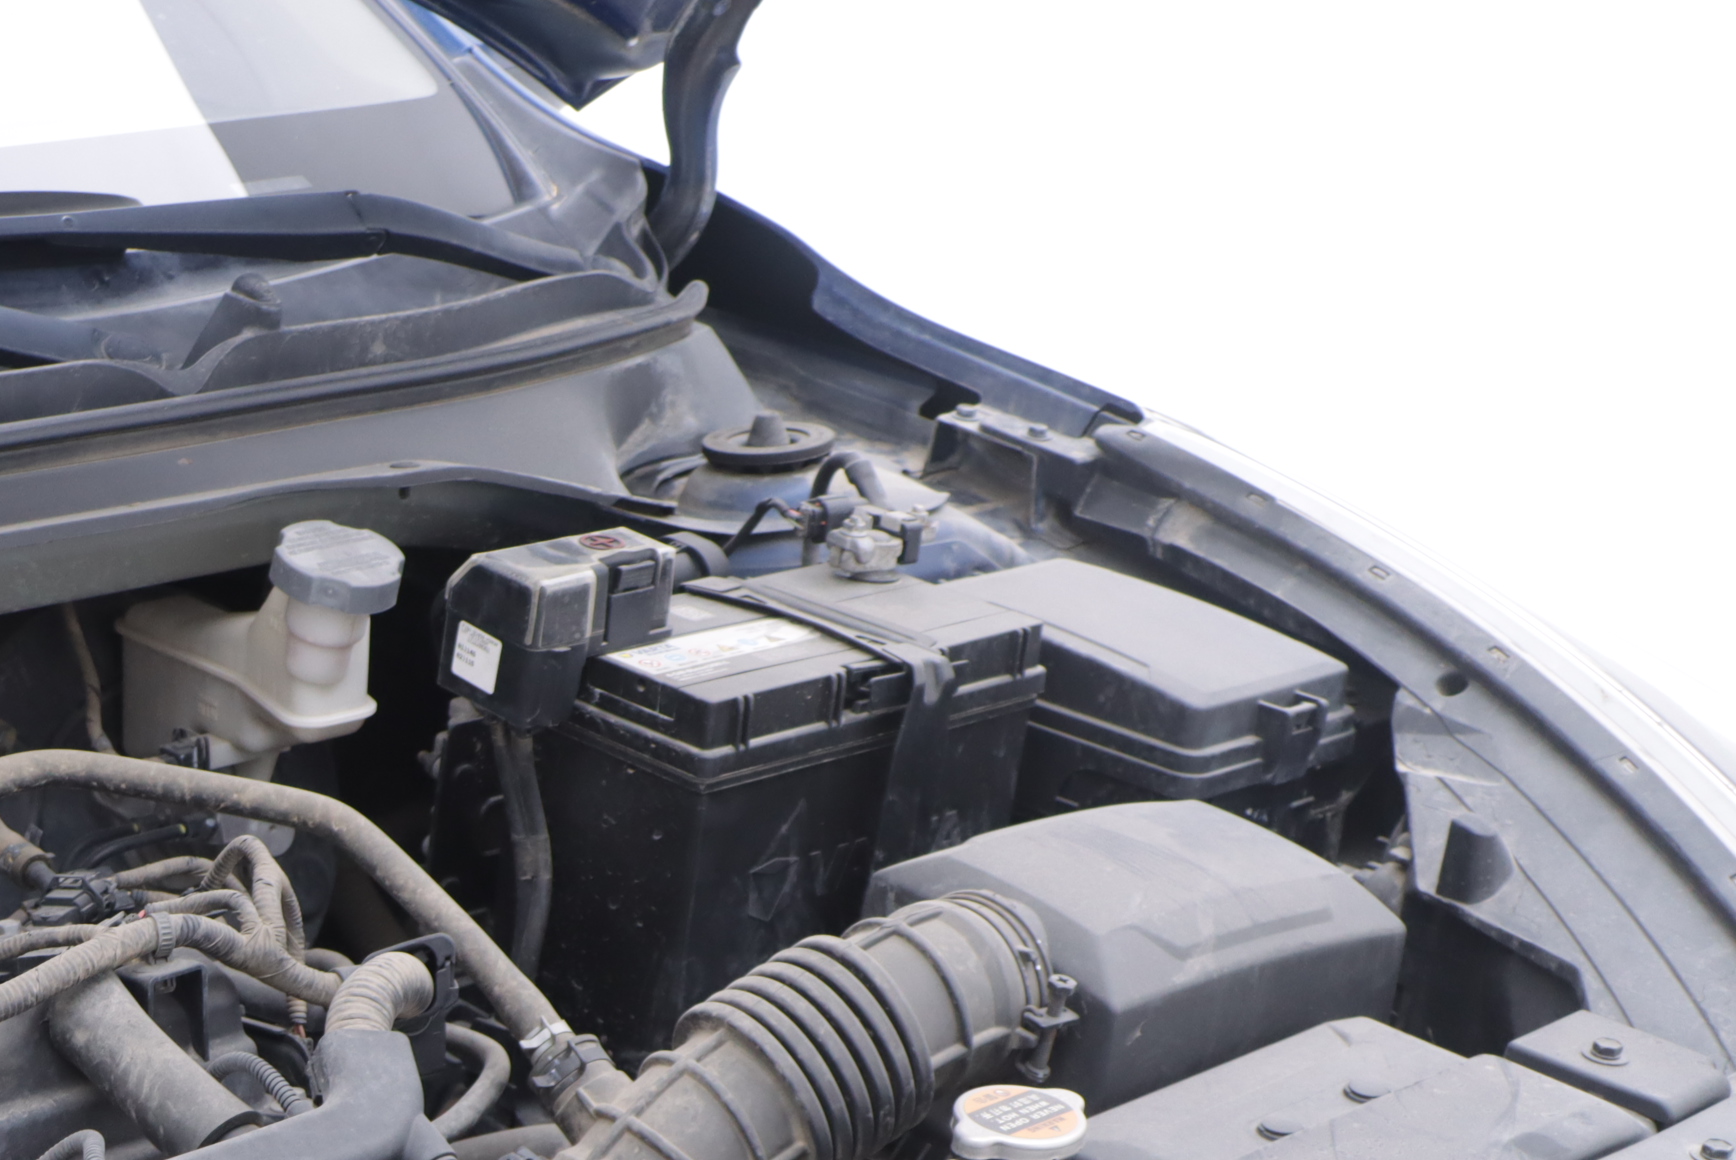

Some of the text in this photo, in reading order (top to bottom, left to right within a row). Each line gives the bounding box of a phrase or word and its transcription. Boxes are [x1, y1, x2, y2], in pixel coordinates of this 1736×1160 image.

[999, 1103, 1065, 1131] NEVER OPEN
[1018, 1101, 1050, 1114] WHEN
